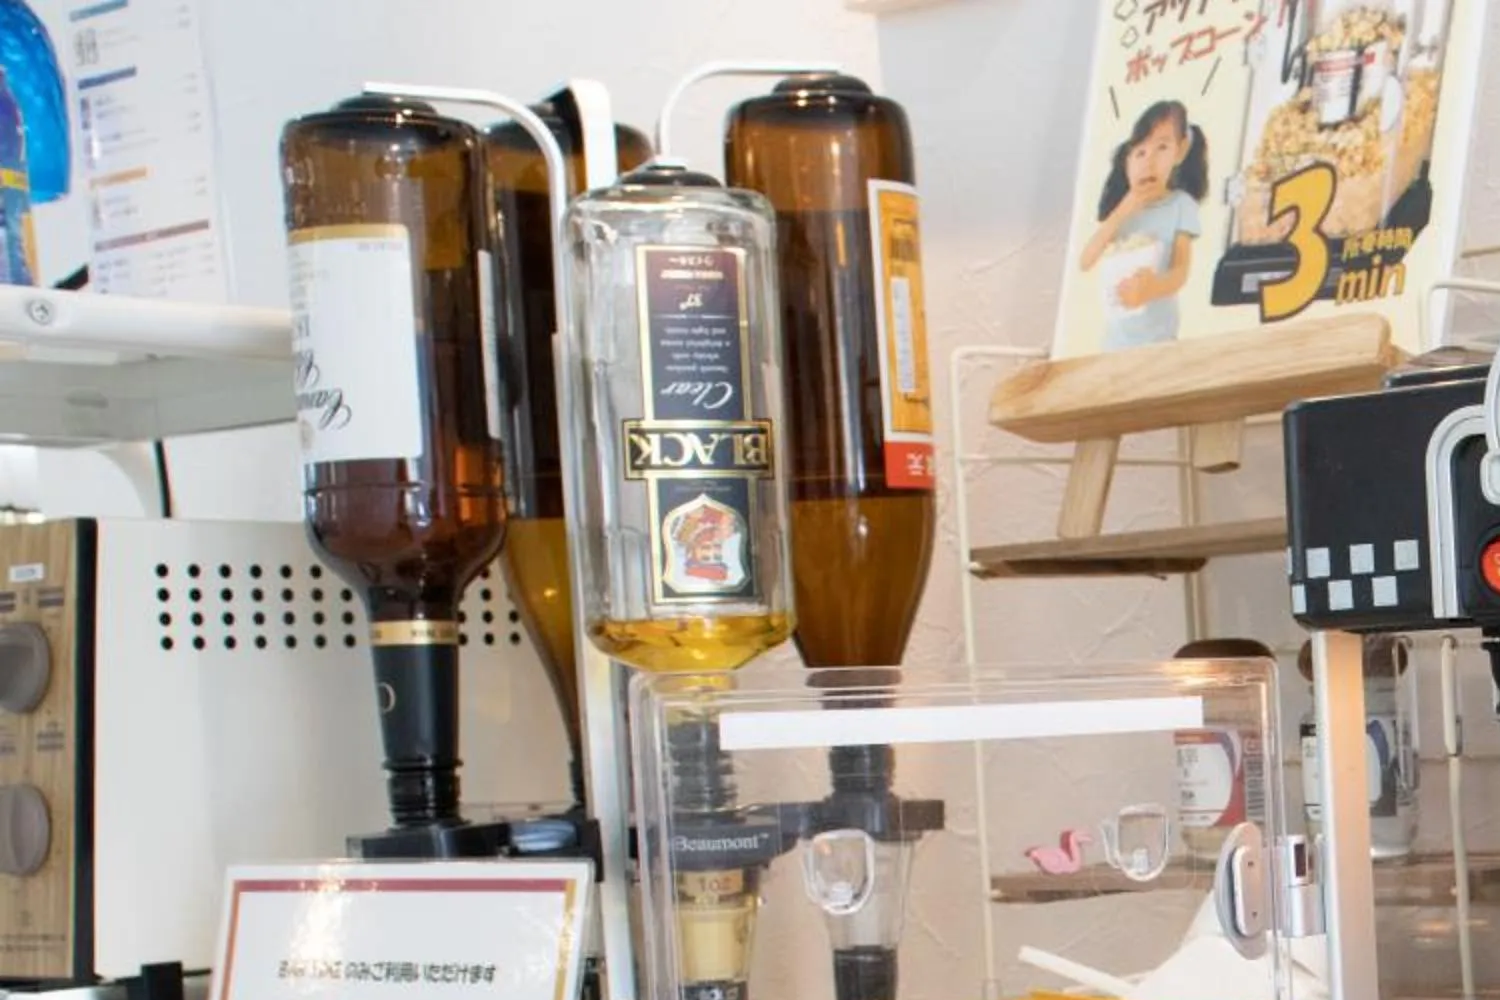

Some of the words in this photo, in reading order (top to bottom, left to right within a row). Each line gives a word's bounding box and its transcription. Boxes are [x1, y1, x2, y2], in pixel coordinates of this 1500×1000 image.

[1259, 160, 1336, 324] 3
[1334, 254, 1407, 306] min
[660, 380, 734, 410] Clear
[628, 432, 769, 467] BLACK
